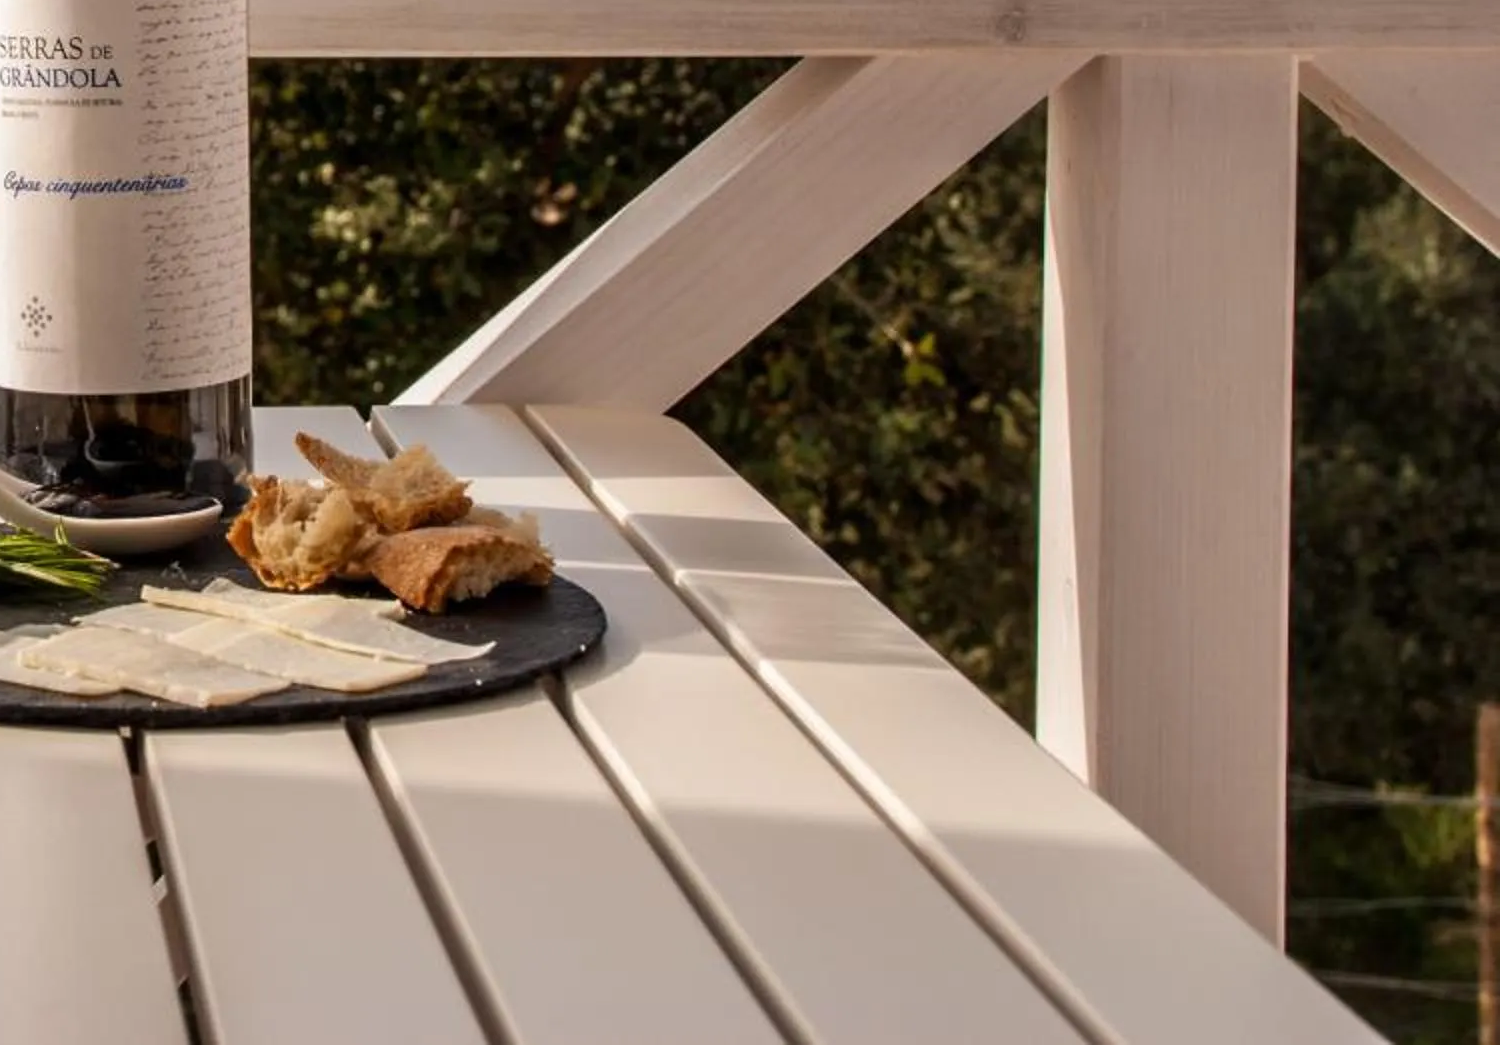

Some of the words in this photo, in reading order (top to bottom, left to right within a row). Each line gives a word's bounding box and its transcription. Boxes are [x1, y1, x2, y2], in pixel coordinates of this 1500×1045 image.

[0, 36, 83, 60] SERRAS
[90, 44, 113, 60] DE
[0, 64, 122, 89] GRÂNDOLA
[3, 170, 41, 199] Cepas
[45, 175, 188, 200] cinquentenárias
